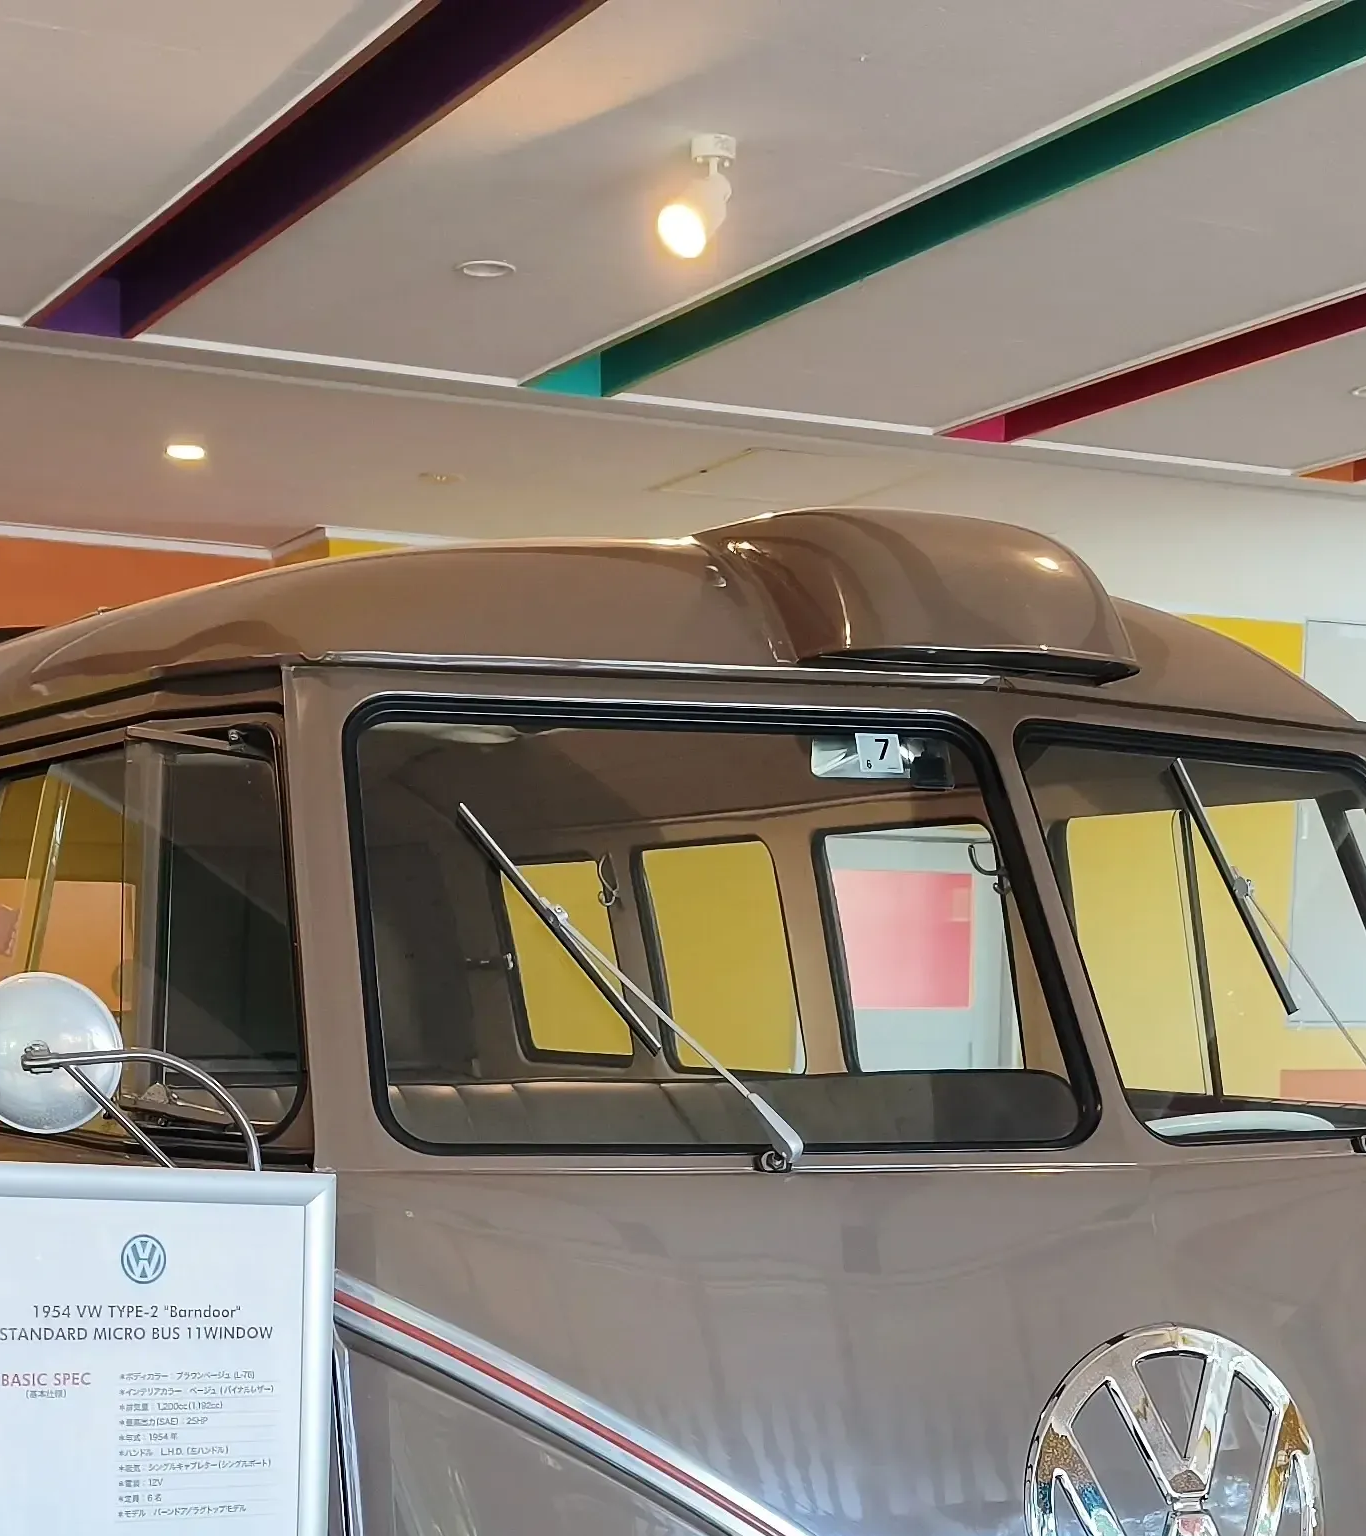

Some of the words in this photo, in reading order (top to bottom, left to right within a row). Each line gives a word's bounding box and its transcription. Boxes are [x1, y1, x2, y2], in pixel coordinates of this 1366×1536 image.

[874, 738, 890, 761] 7
[866, 759, 873, 769] 6
[33, 1304, 72, 1319] 1954
[76, 1304, 103, 1318] VW
[107, 1304, 159, 1319] TYPE-2
[0, 1327, 87, 1341] STANDARD
[93, 1327, 146, 1341] MICRO
[151, 1326, 181, 1340] BUS
[186, 1326, 274, 1340] 11WINDOW
[1, 1373, 48, 1386] BASIC
[53, 1372, 92, 1386] SPEC
